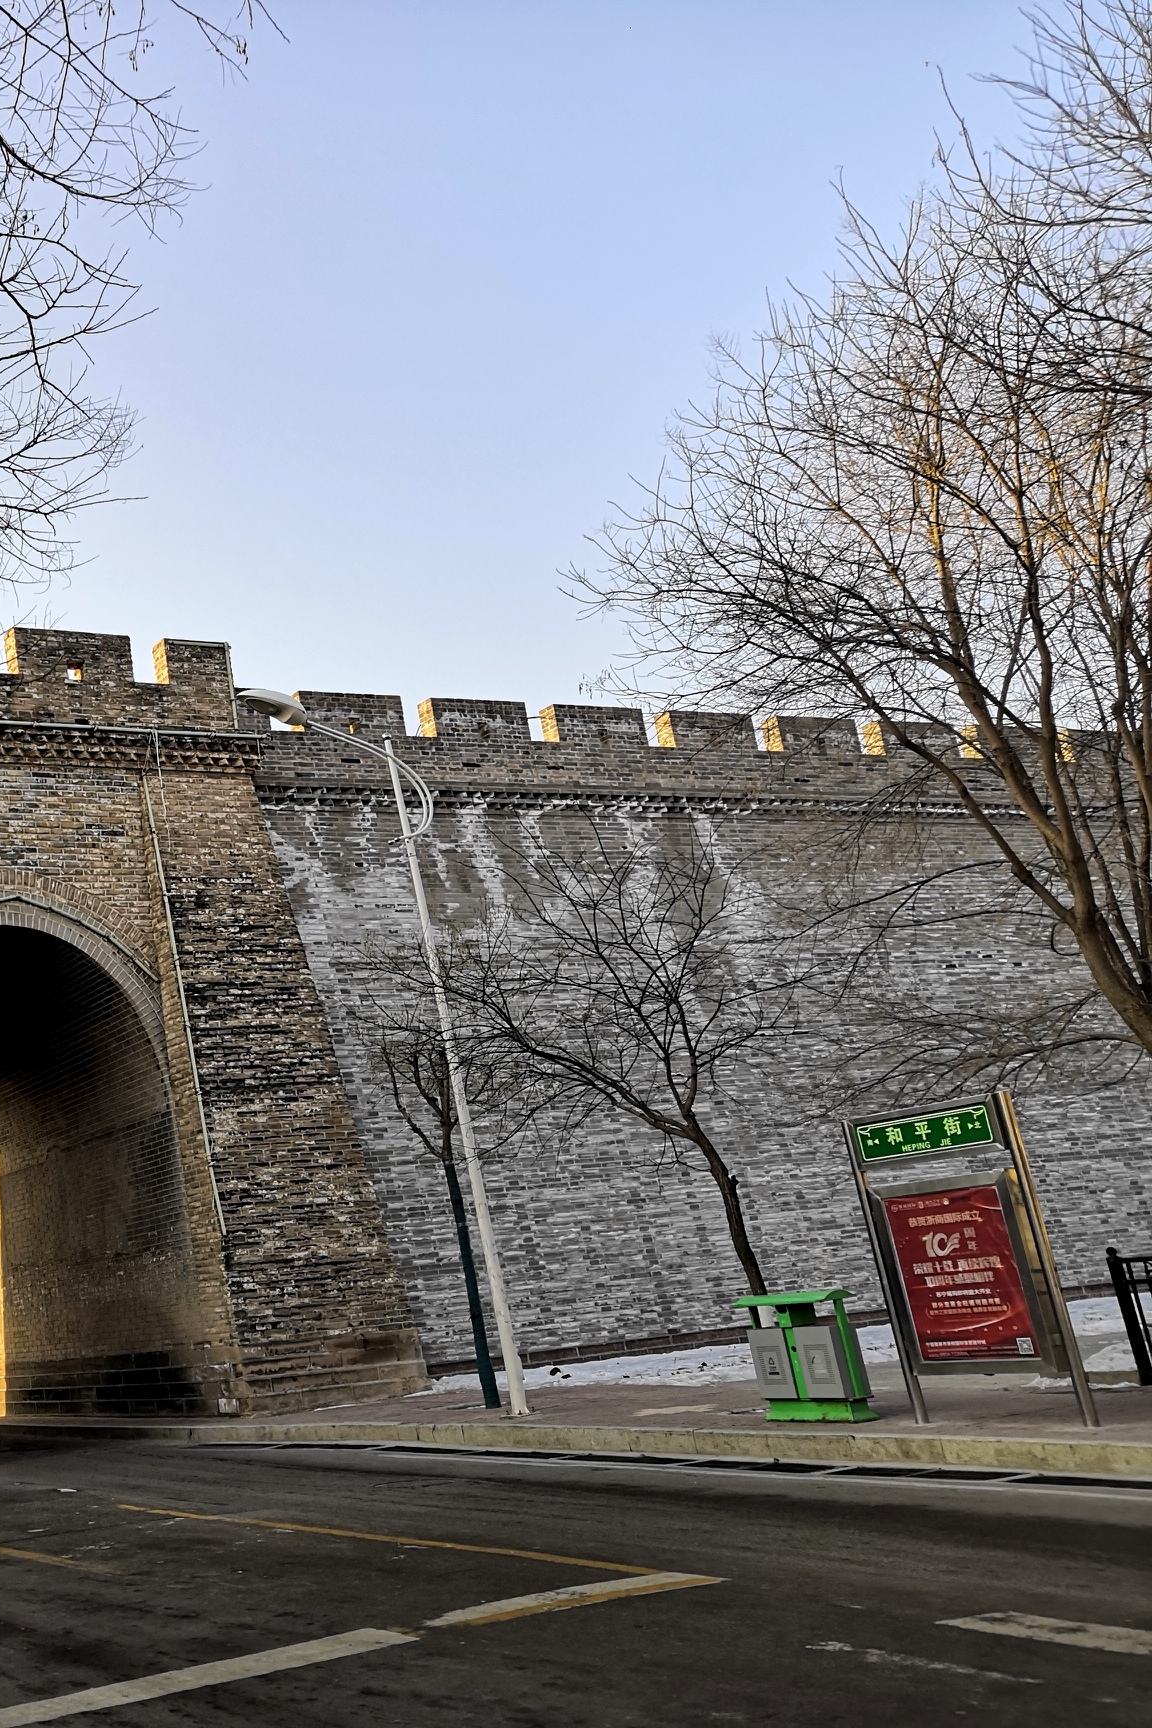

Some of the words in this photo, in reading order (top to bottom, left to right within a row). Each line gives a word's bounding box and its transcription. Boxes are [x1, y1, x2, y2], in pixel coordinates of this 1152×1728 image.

[885, 1116, 962, 1146] 和平街
[901, 1141, 931, 1153] HEPING
[939, 1137, 952, 1147] JIE
